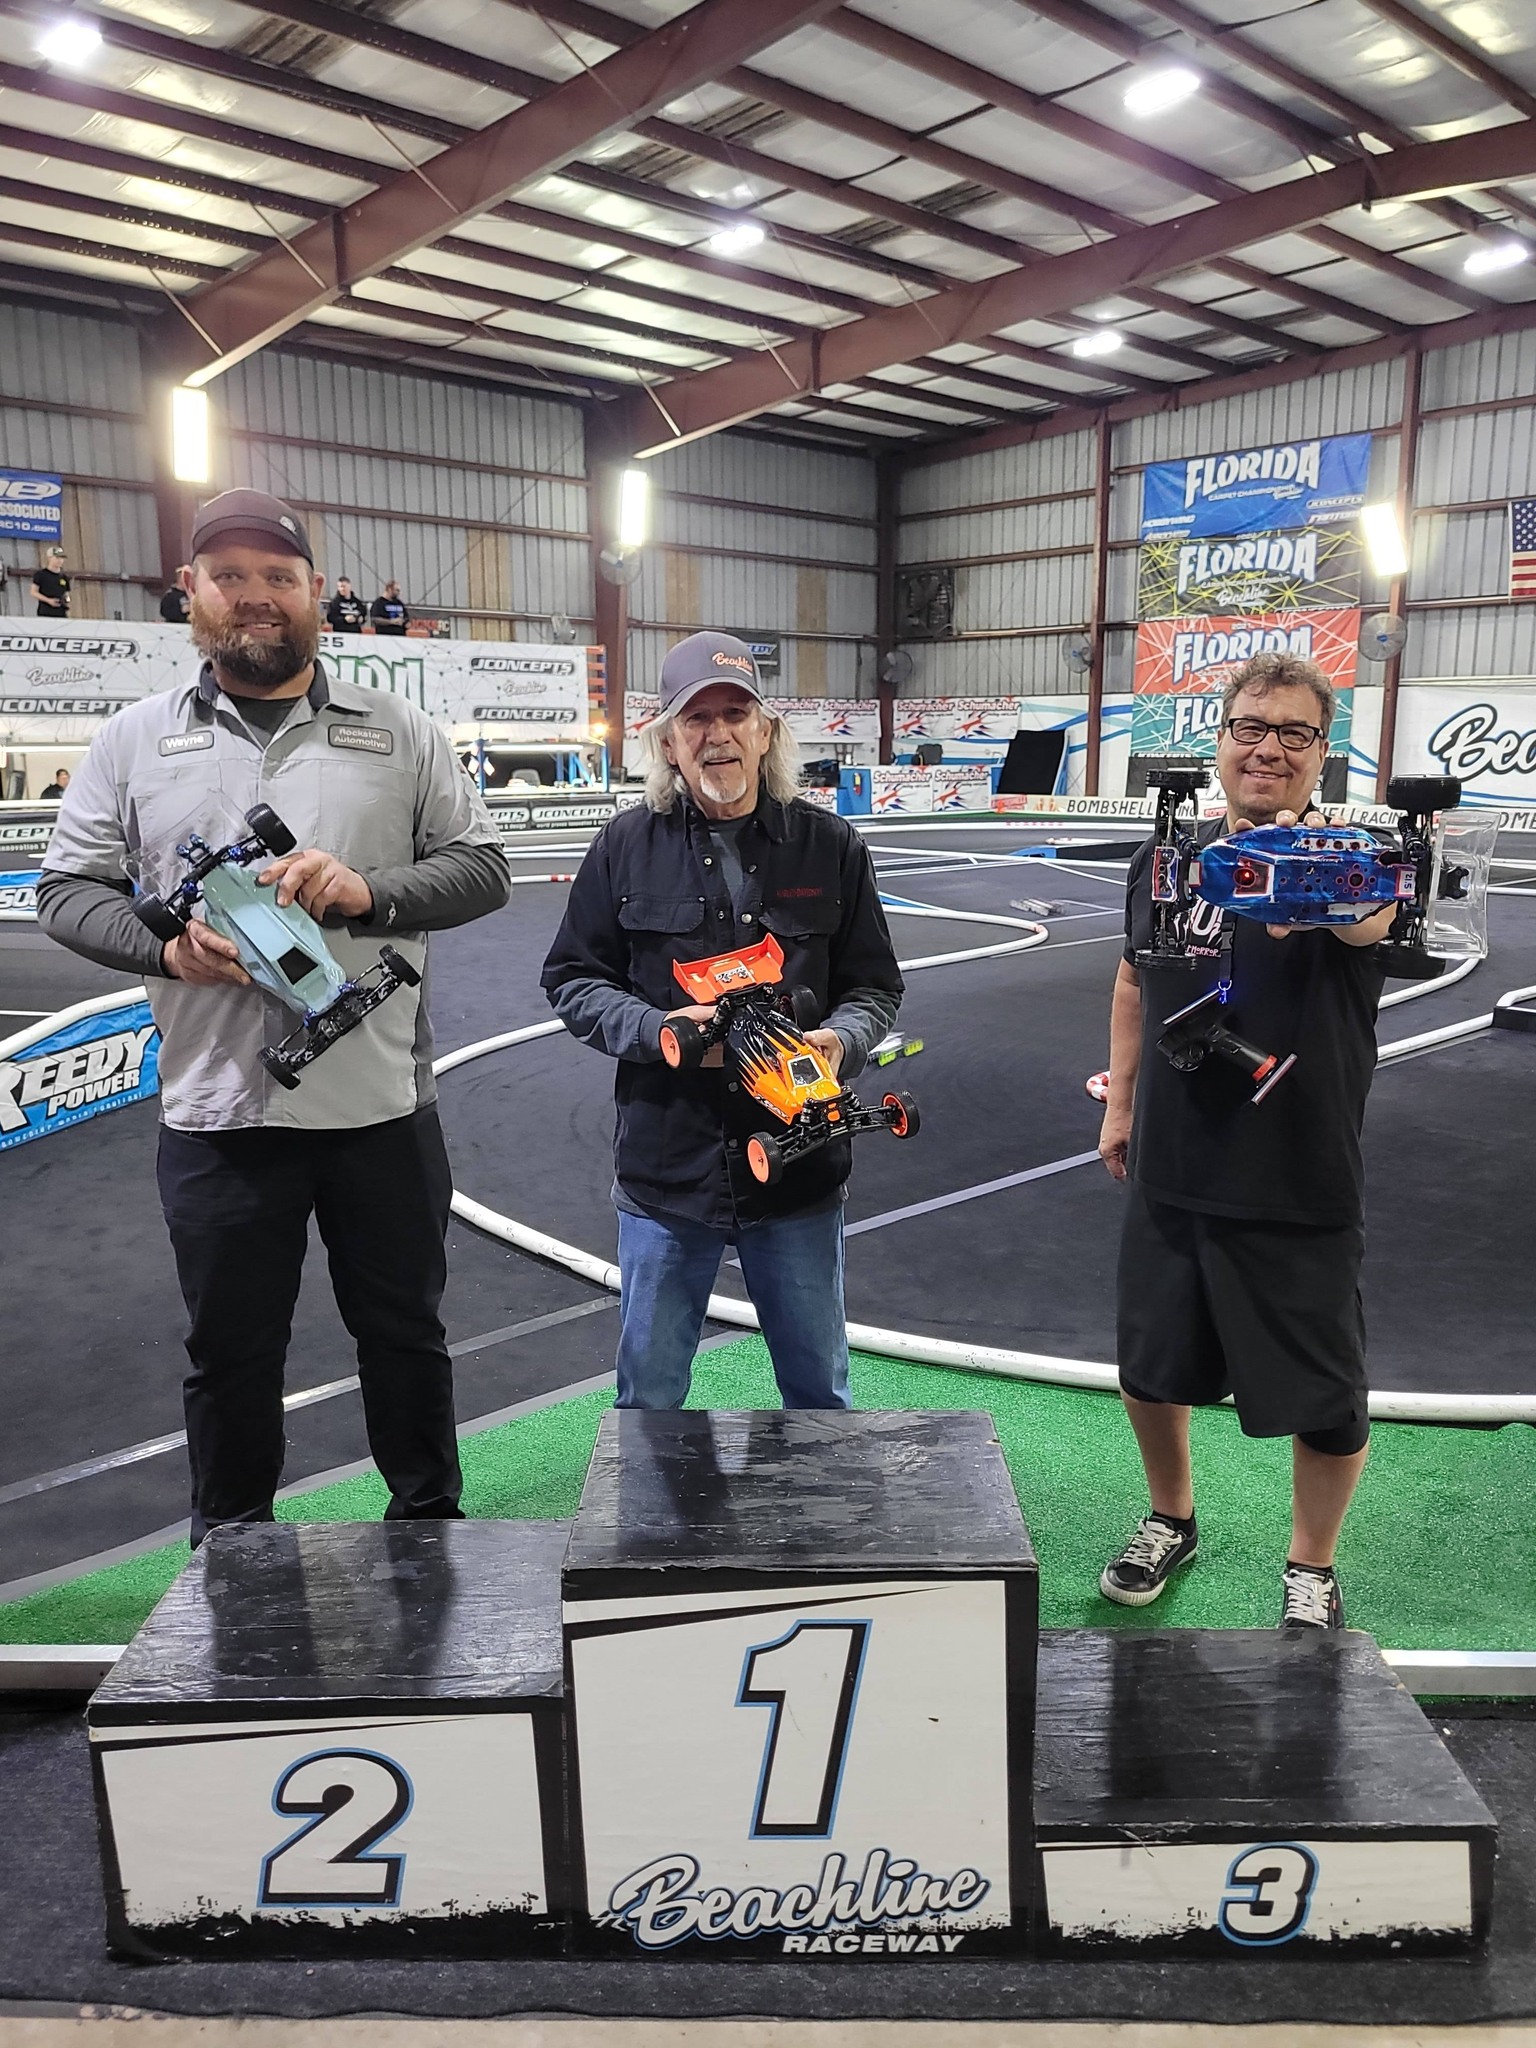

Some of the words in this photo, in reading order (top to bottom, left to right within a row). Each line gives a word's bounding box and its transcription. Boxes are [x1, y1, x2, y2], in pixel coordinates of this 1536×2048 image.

[1184, 441, 1321, 509] FLORIDA
[0, 501, 60, 521] SSOCIATED
[1178, 533, 1317, 595] FLORIDA
[1173, 625, 1312, 683] FLORIDA
[473, 657, 573, 676] JCONCEPTS
[26, 666, 94, 687] Beachline
[766, 699, 820, 711] chumacher
[898, 700, 955, 712] Schumacher
[957, 699, 1020, 712] Schumacher
[474, 707, 576, 723] JCONCEPTS
[1174, 697, 1223, 744] FLO
[165, 735, 204, 749] Wayne
[334, 735, 387, 749] Automotive
[339, 728, 381, 739] Rockstar
[1427, 703, 1536, 784] Bea
[873, 770, 932, 783] Schumacher
[934, 769, 989, 782] Schumacher
[490, 811, 526, 821] EPTS
[536, 806, 613, 820] JCONCEPTS
[1067, 800, 1153, 816] BOMBSHELL
[1360, 811, 1403, 824] RACIN
[0, 1025, 157, 1132] REEDY
[47, 1069, 140, 1117] POWER
[735, 1619, 873, 1840] 1
[257, 1747, 415, 1907] 2
[612, 1848, 991, 1950] Beachline
[1218, 1842, 1320, 1947] 3
[782, 1933, 965, 1954] RACEWAY
